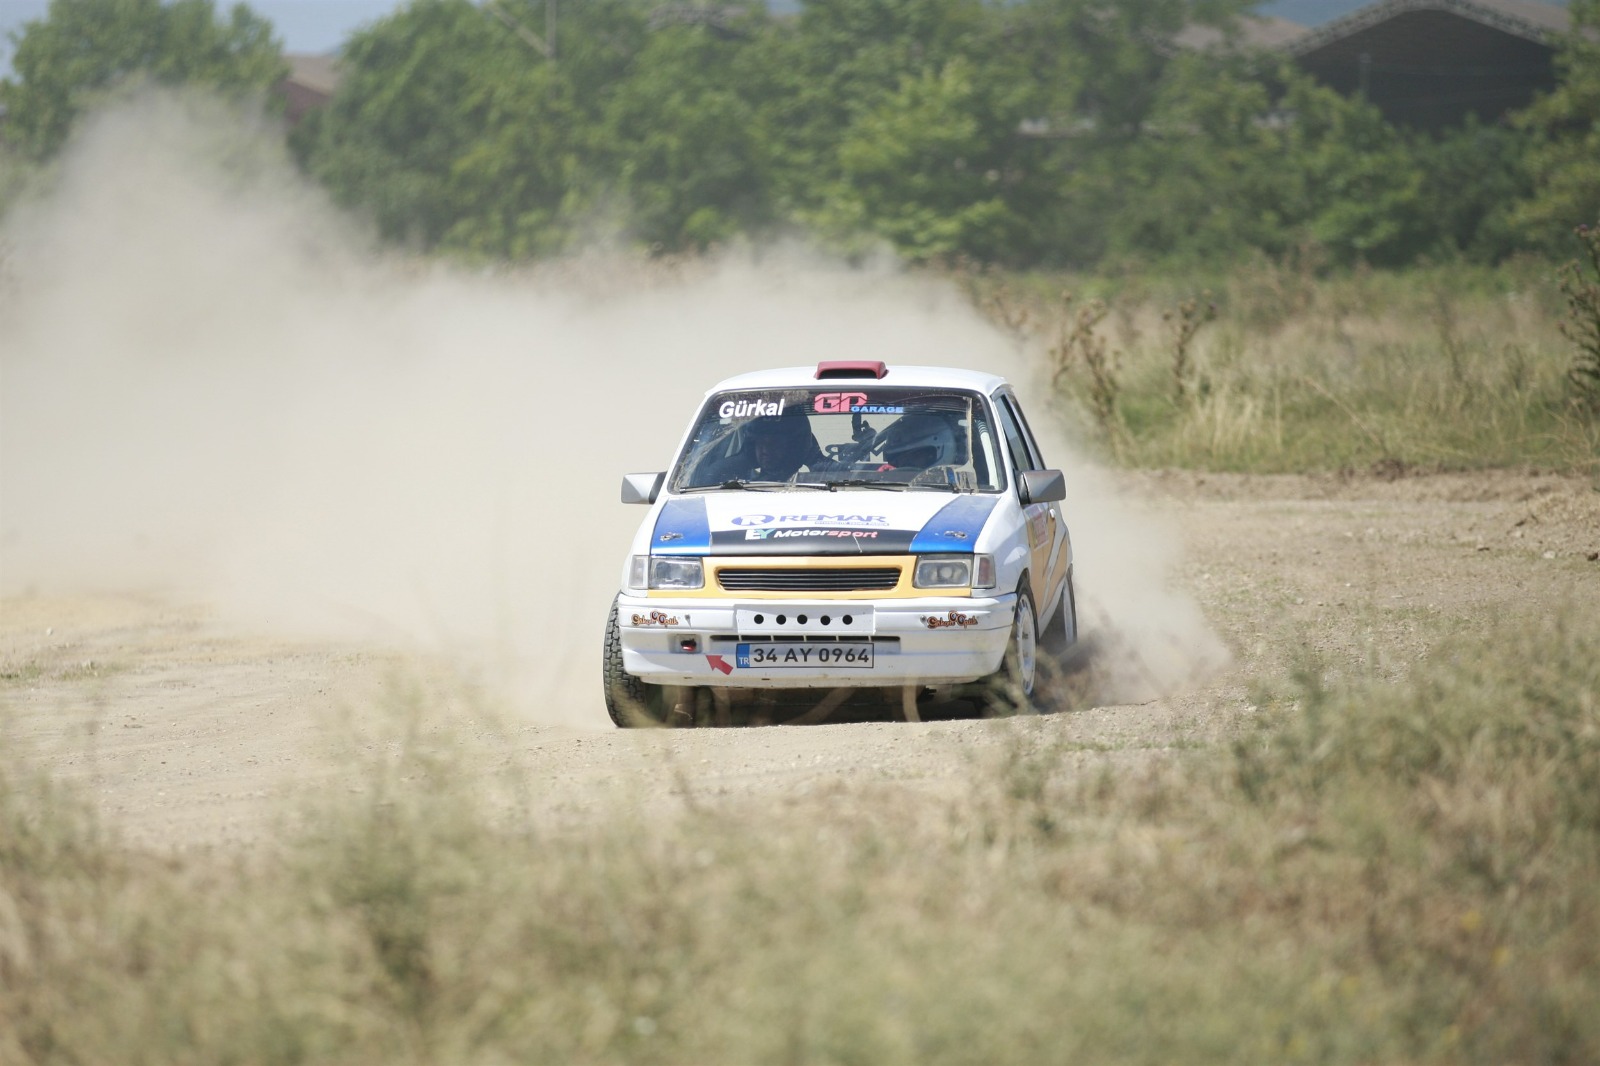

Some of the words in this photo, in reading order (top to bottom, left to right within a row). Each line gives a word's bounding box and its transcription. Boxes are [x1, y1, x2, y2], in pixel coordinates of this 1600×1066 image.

[719, 398, 785, 418] Gürkal
[814, 392, 868, 413] GP
[779, 514, 887, 523] REMAR
[773, 529, 878, 539] Motorsport
[739, 656, 750, 665] TR
[753, 648, 777, 663] 34
[784, 648, 813, 663] AY
[818, 648, 869, 663] 0964
